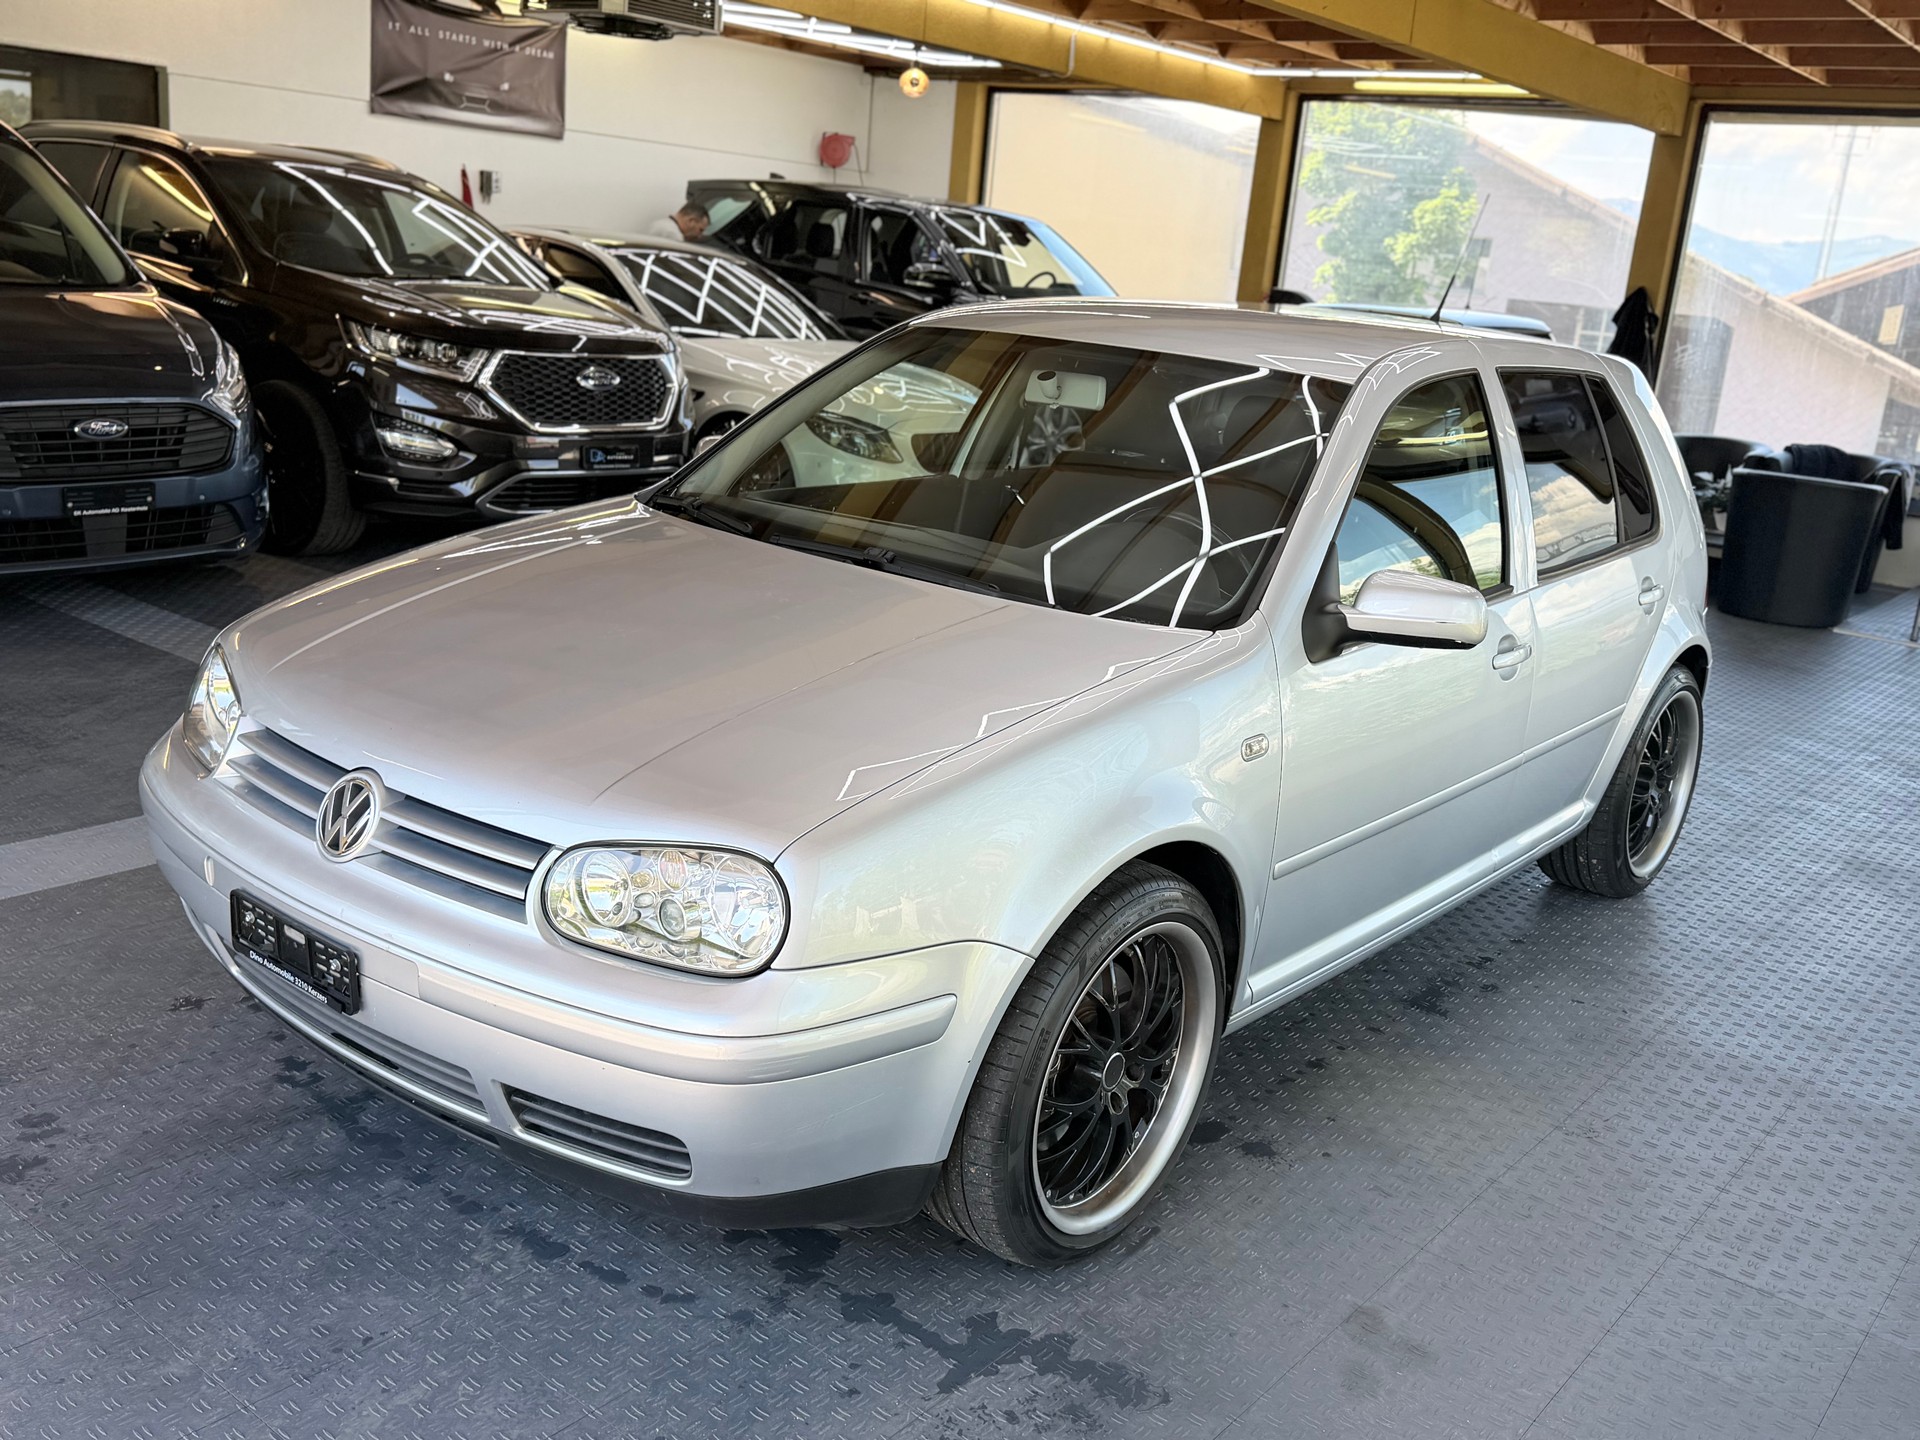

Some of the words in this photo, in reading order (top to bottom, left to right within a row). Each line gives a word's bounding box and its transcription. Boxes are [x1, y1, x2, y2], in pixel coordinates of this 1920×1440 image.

[387, 20, 401, 32] IT
[408, 24, 430, 37] ALL
[438, 29, 477, 46] STARTS
[482, 38, 510, 51] WITH
[524, 45, 555, 60] DREAM
[318, 776, 375, 857] VW
[249, 949, 264, 964] Dino
[263, 958, 295, 983] Automobile
[294, 976, 308, 991] 3210
[307, 984, 328, 1004] Kerzers
[1023, 1028, 1051, 1085] PIRELLI
